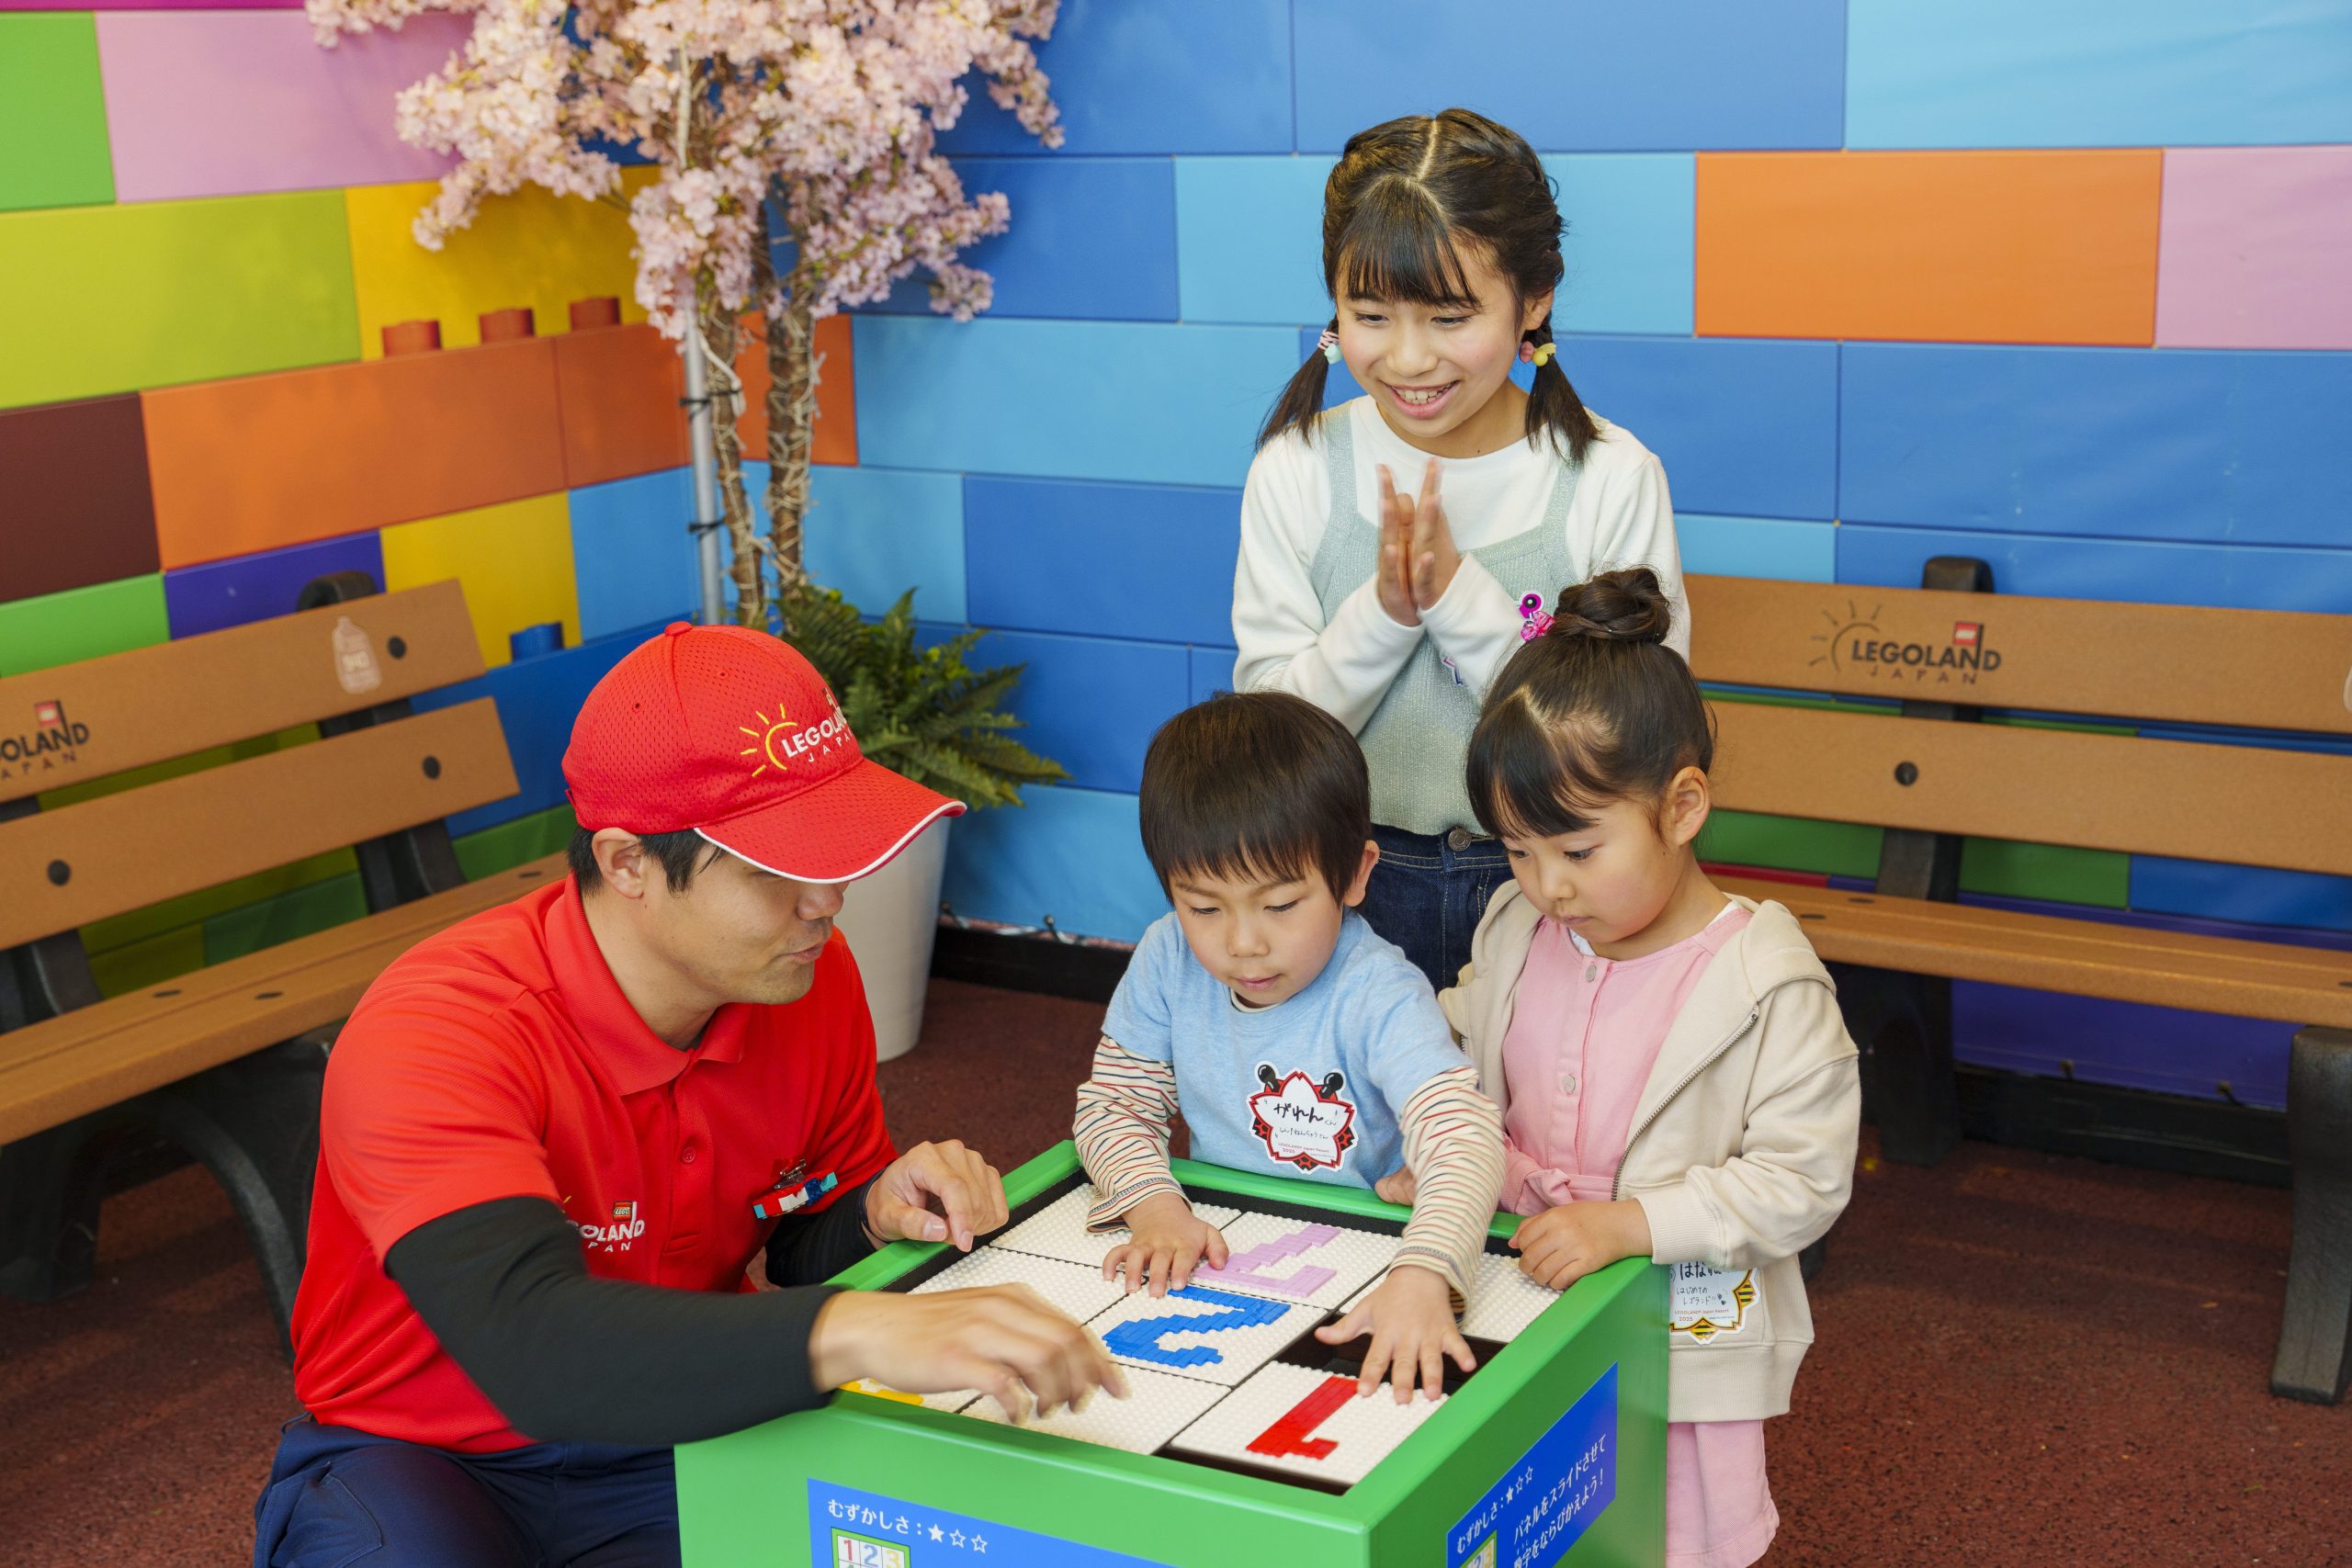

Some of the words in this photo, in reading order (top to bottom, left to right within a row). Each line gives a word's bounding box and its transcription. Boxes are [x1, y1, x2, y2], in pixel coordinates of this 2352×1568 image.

[1851, 624, 2002, 671] LEGOLAND
[1870, 666, 1977, 684] JAPAN
[0, 699, 90, 761] OLAND
[781, 687, 847, 758] LEGOLAN
[1, 752, 76, 779] APAN
[1677, 1286, 1708, 1295] はじめての
[1514, 1434, 1607, 1545] パネルをスライドさせて
[843, 1540, 853, 1562] 1
[864, 1544, 878, 1568] 2
